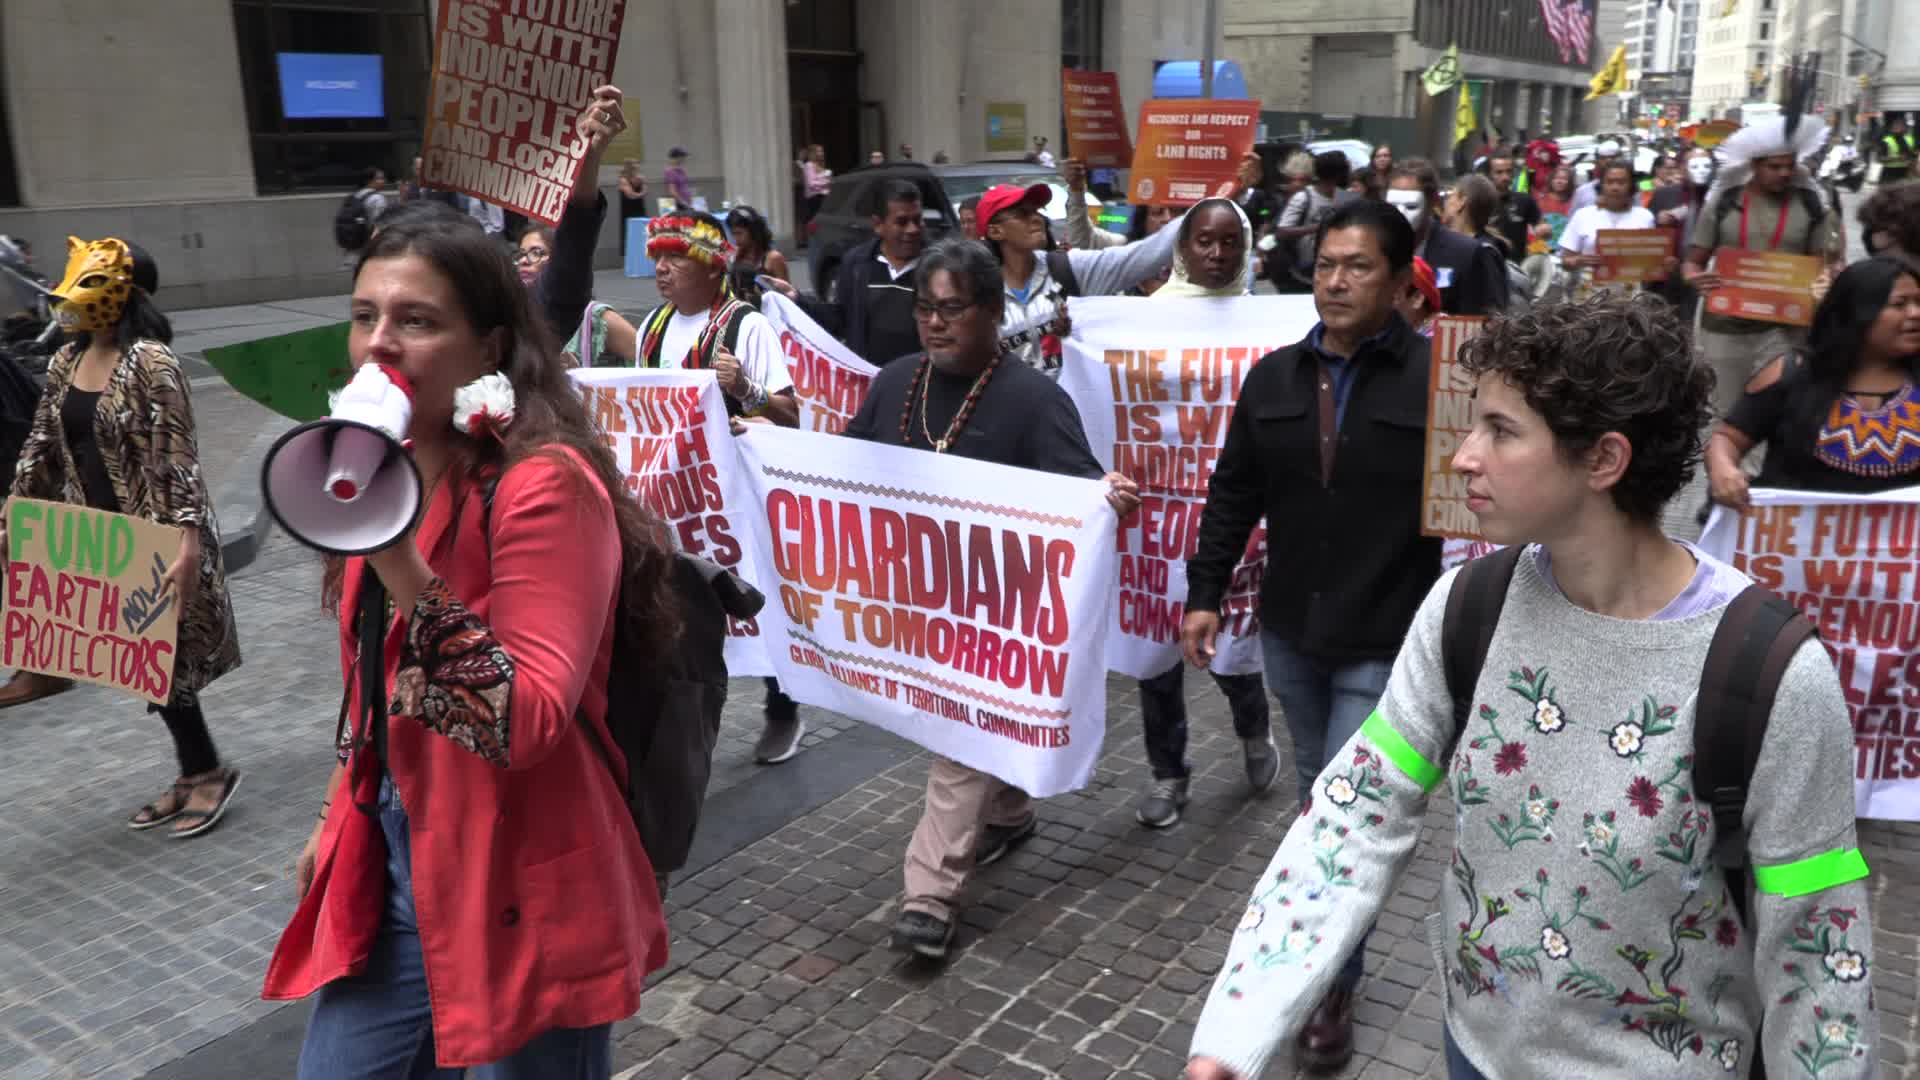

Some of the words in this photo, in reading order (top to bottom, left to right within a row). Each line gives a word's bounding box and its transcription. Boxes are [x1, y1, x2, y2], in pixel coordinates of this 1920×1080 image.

[447, 2, 490, 38] IS
[502, 15, 610, 71] WITH
[433, 74, 590, 160] PEOPLES
[1210, 114, 1250, 126] RESPECT
[423, 151, 571, 223] COMMUNITIES
[430, 123, 490, 158] AND
[497, 138, 578, 189] LOCAL
[1156, 145, 1185, 159] LAND
[1187, 145, 1228, 160] RIGHTS
[1104, 349, 1168, 401] THE
[1180, 347, 1274, 401] FUT
[1114, 404, 1162, 442] IS
[1176, 404, 1236, 445] WI
[11, 501, 135, 578] FUND
[1734, 505, 1802, 557] THE
[1811, 504, 1920, 558] FUTU
[8, 561, 120, 633] EARTH
[766, 488, 1076, 647] GUARDIANS
[1120, 554, 1168, 596] AND
[4, 611, 173, 699] PROTECTORS
[779, 583, 824, 632] OF
[834, 597, 1069, 698] TOMORROW
[789, 644, 829, 674] GLOBAL
[829, 661, 881, 697] ALLIANCE
[885, 676, 898, 700] OF
[903, 683, 975, 726] TERRITORIAL
[976, 707, 1071, 748] COMMUNITIES
